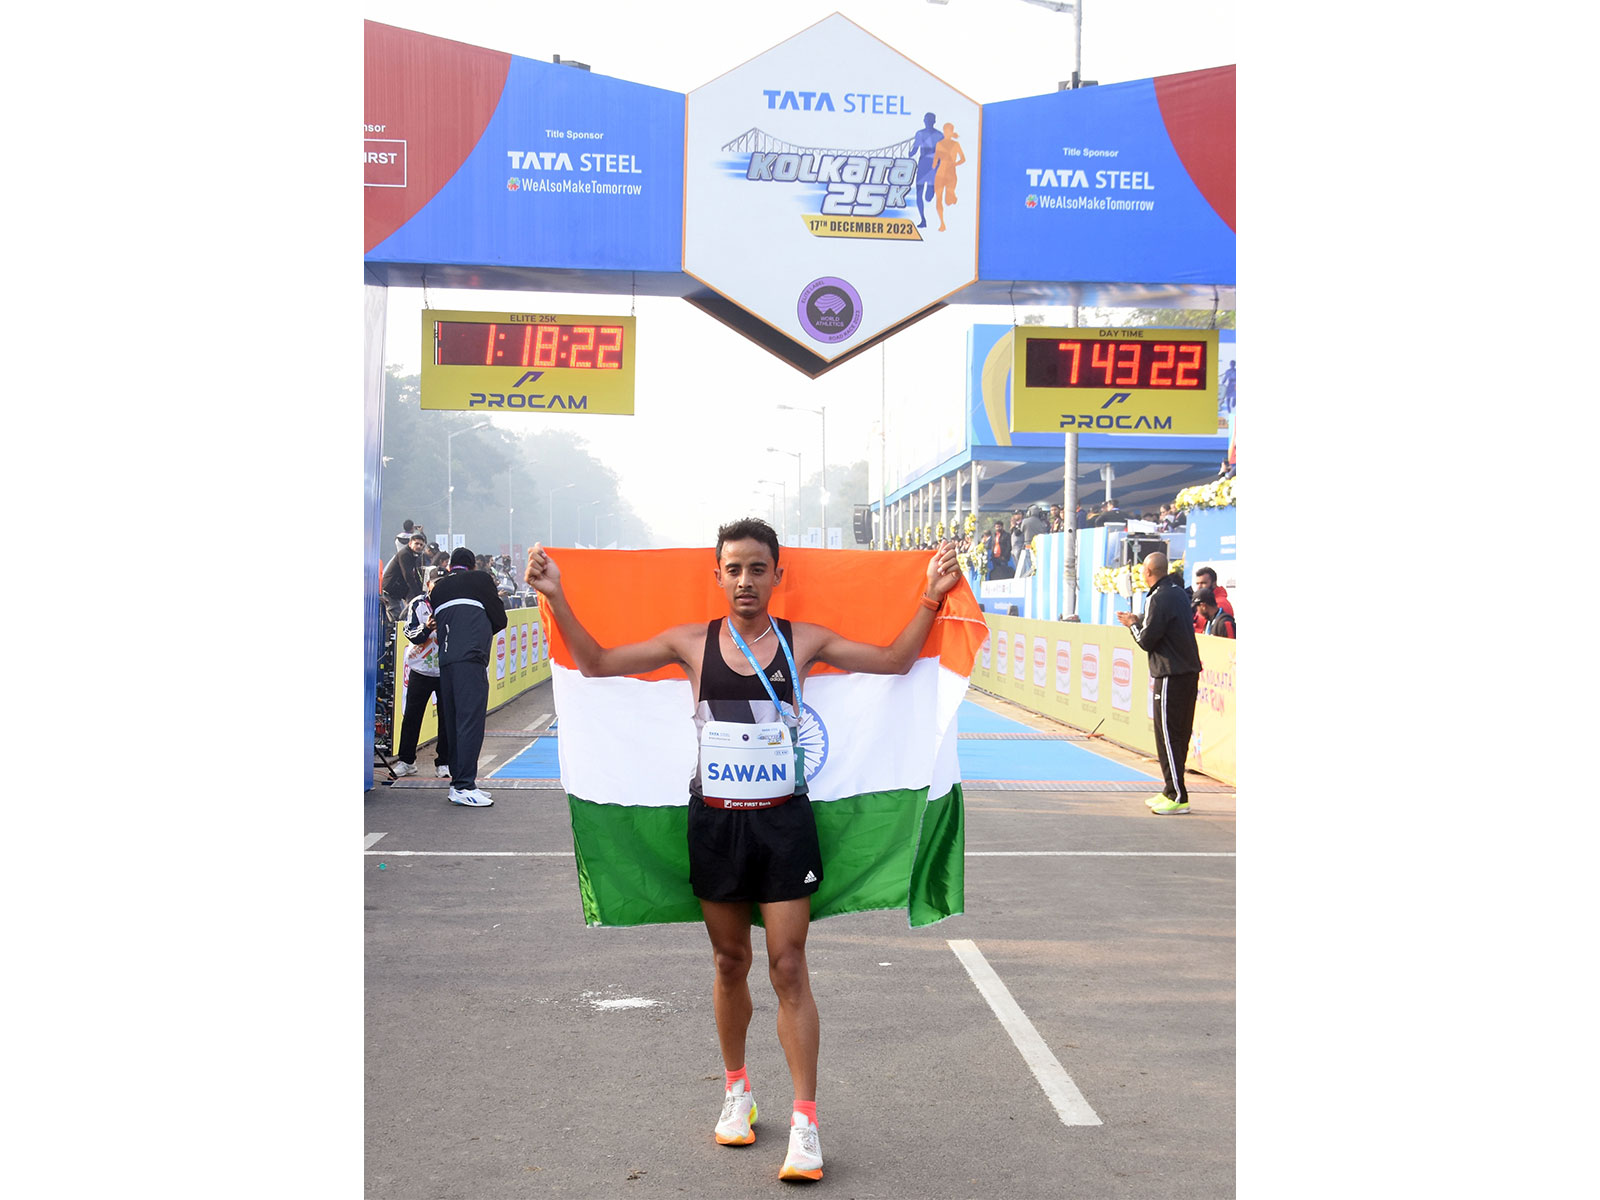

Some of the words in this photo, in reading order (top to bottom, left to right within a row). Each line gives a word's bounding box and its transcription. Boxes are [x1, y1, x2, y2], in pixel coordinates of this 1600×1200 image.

[763, 89, 835, 112] TATA
[843, 93, 911, 115] STEEL
[545, 129, 564, 139] Title
[567, 130, 604, 140] Sponsor
[1063, 148, 1081, 157] Title
[1083, 148, 1119, 158] Sponsor
[507, 151, 574, 171] TATA
[580, 153, 642, 174] STEEL
[1026, 168, 1089, 188] TATA
[1095, 170, 1155, 190] STEEL
[820, 183, 910, 217] 25K
[830, 220, 884, 234] DECEMBER
[886, 221, 913, 235] 2023
[510, 314, 536, 323] ELITE
[538, 315, 557, 323] 25K
[1099, 329, 1120, 338] DAY
[1122, 330, 1144, 338] TIME
[1058, 343, 1081, 385] 7
[1091, 343, 1141, 385] 43
[1150, 344, 1202, 386] 22
[469, 393, 587, 409] PROCAM
[1059, 415, 1172, 429] PROCAM
[707, 762, 787, 782] SAWAN
